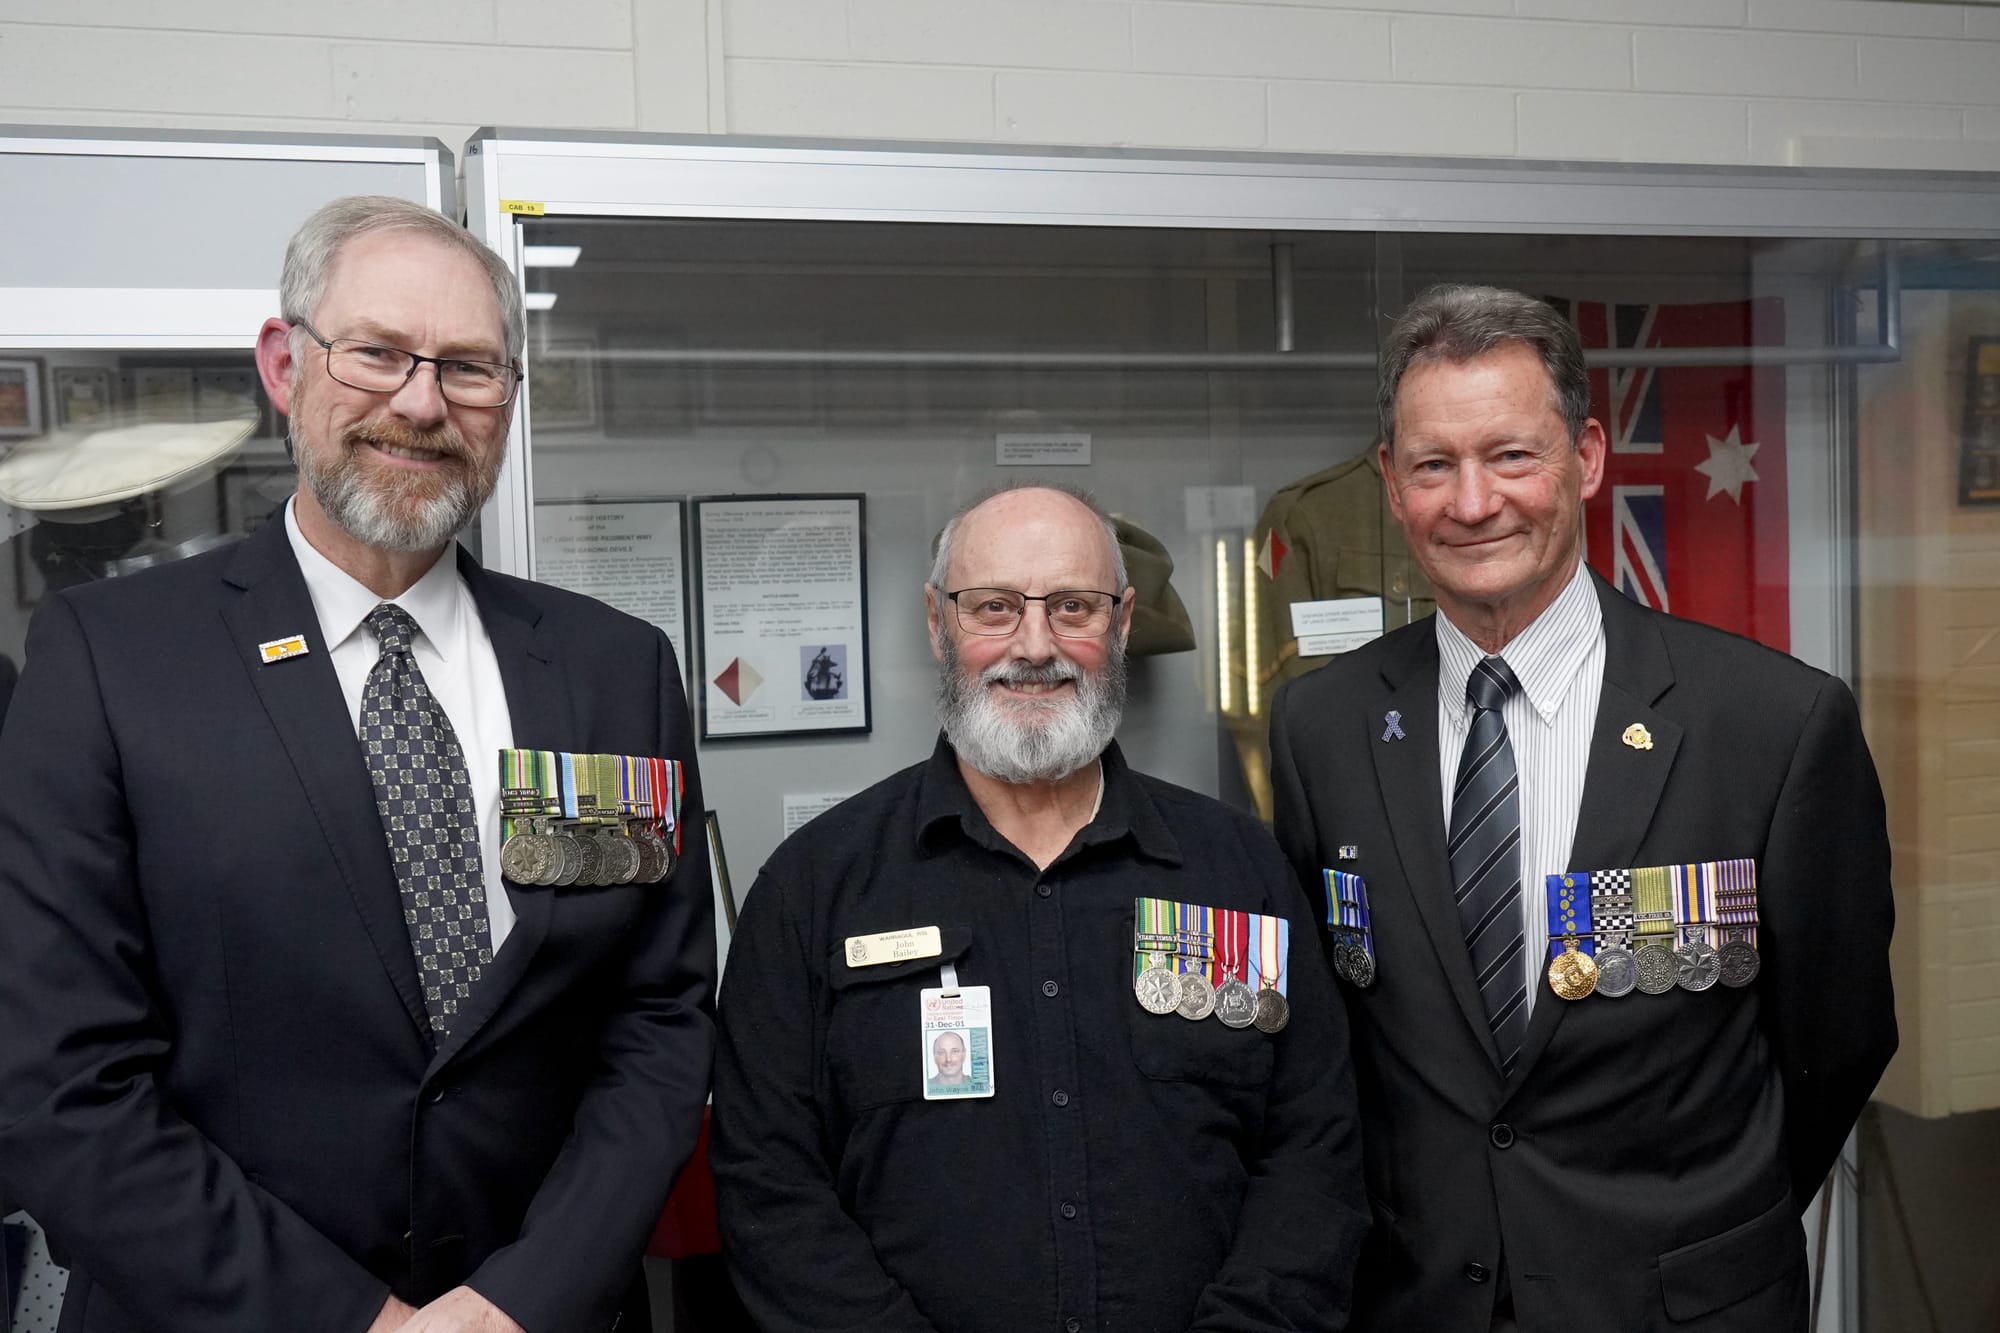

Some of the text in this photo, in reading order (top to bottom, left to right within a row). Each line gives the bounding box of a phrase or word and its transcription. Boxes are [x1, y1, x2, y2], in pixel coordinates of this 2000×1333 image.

[469, 144, 478, 154] 16
[896, 940, 915, 949] John
[893, 948, 919, 959] Bailey
